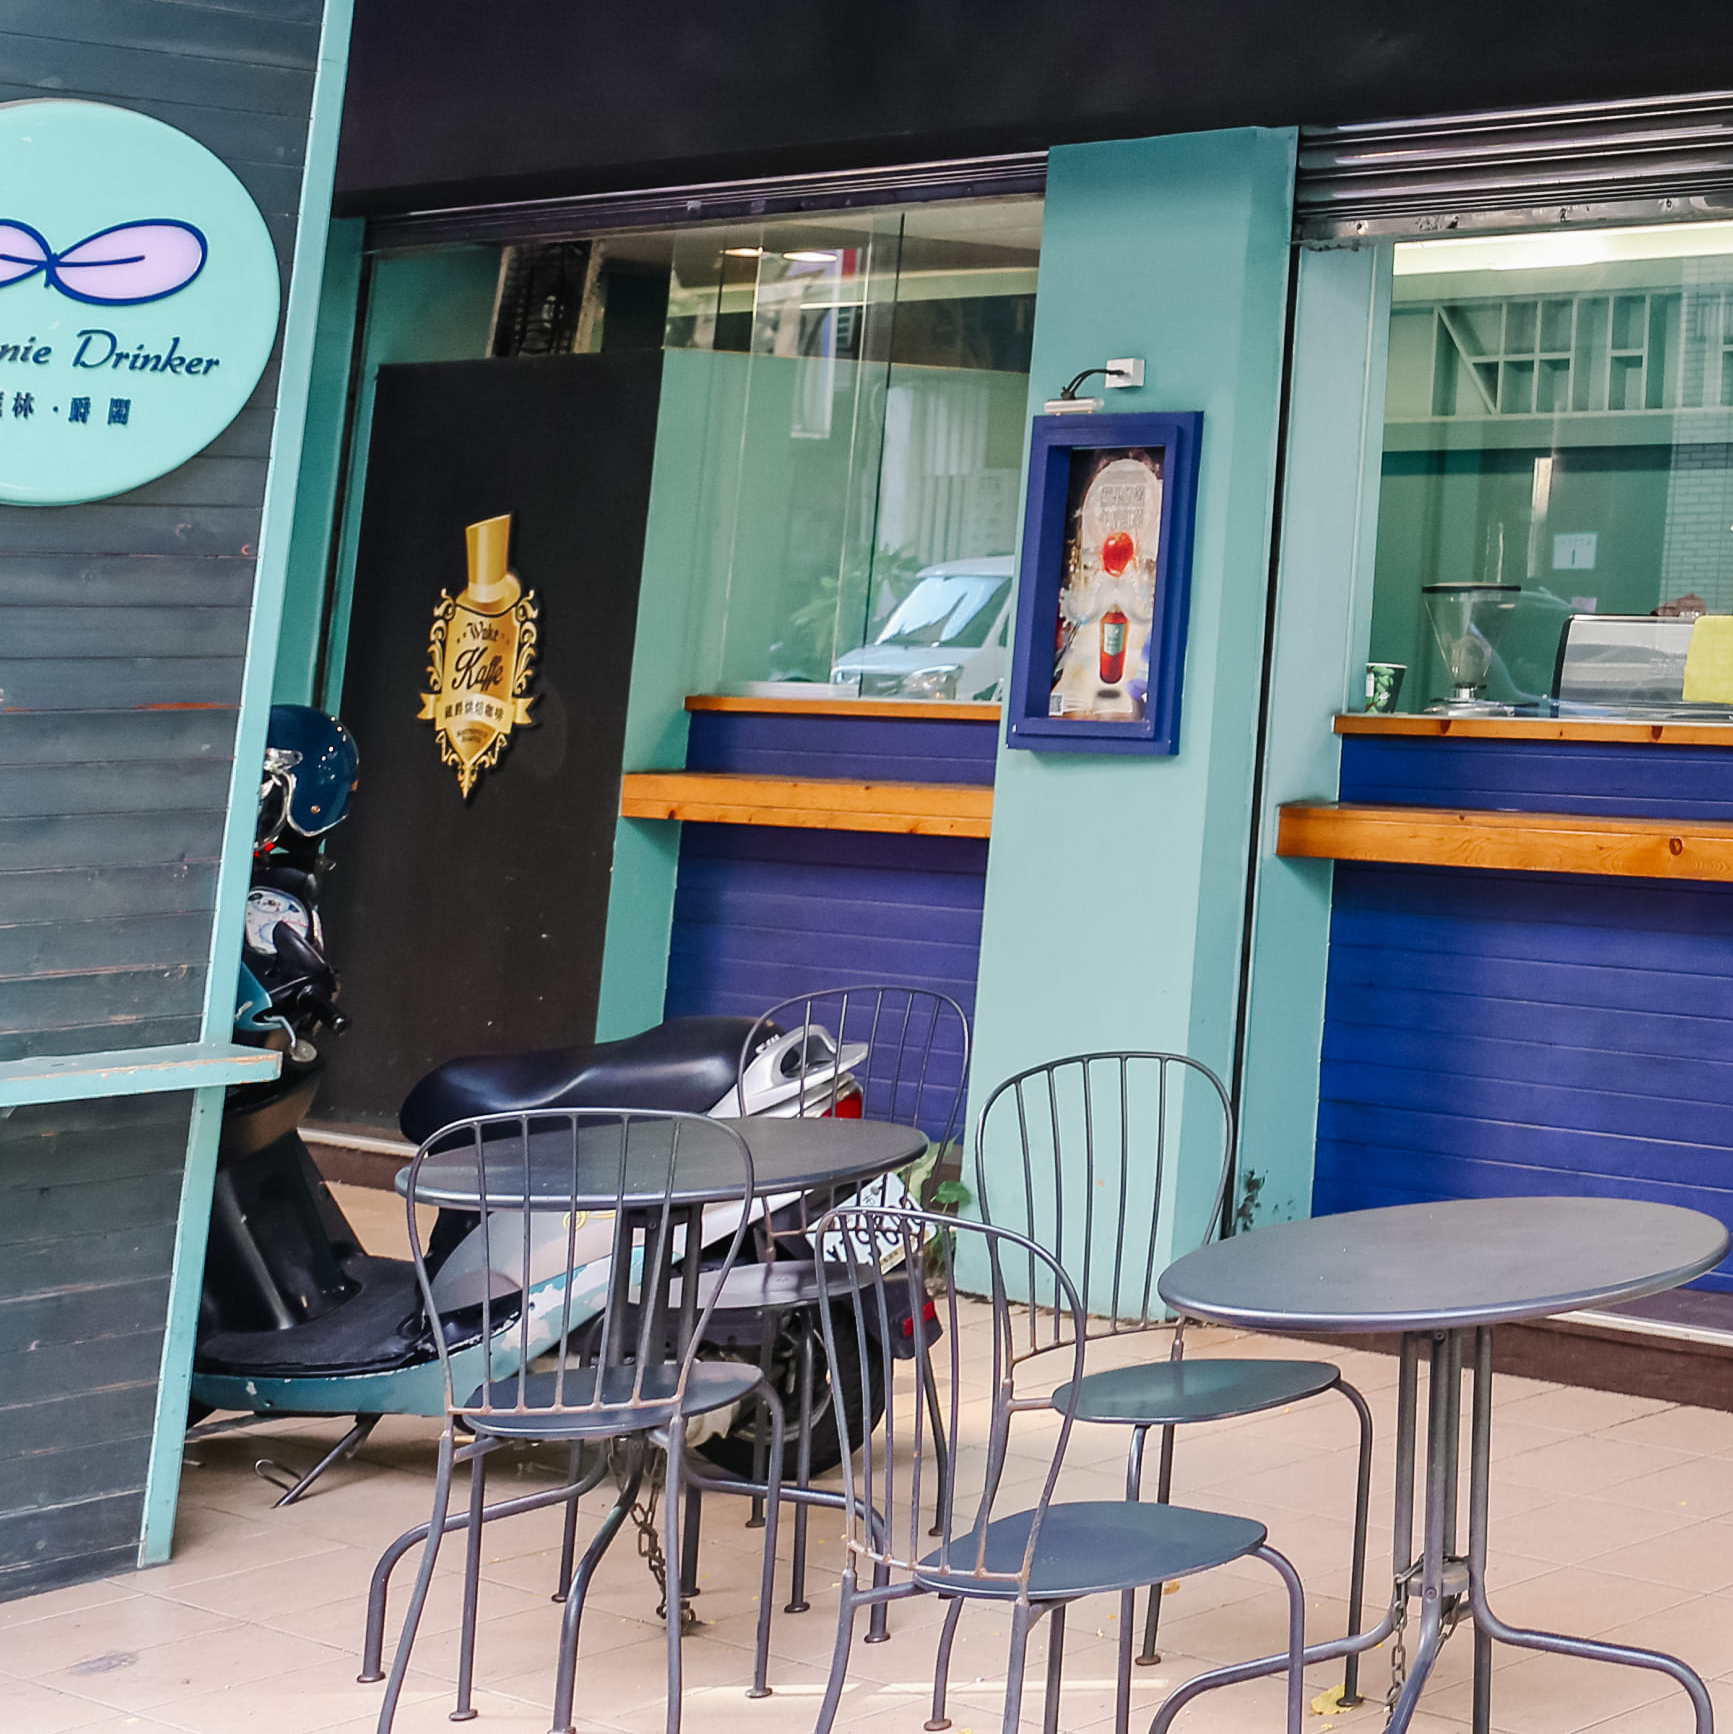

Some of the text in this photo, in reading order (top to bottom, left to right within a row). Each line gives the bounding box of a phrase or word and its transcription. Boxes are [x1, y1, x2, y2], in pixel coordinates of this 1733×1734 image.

[72, 329, 220, 376] Drinker
[0, 391, 131, 426] 林·爵閣
[452, 646, 504, 692] Kaffe
